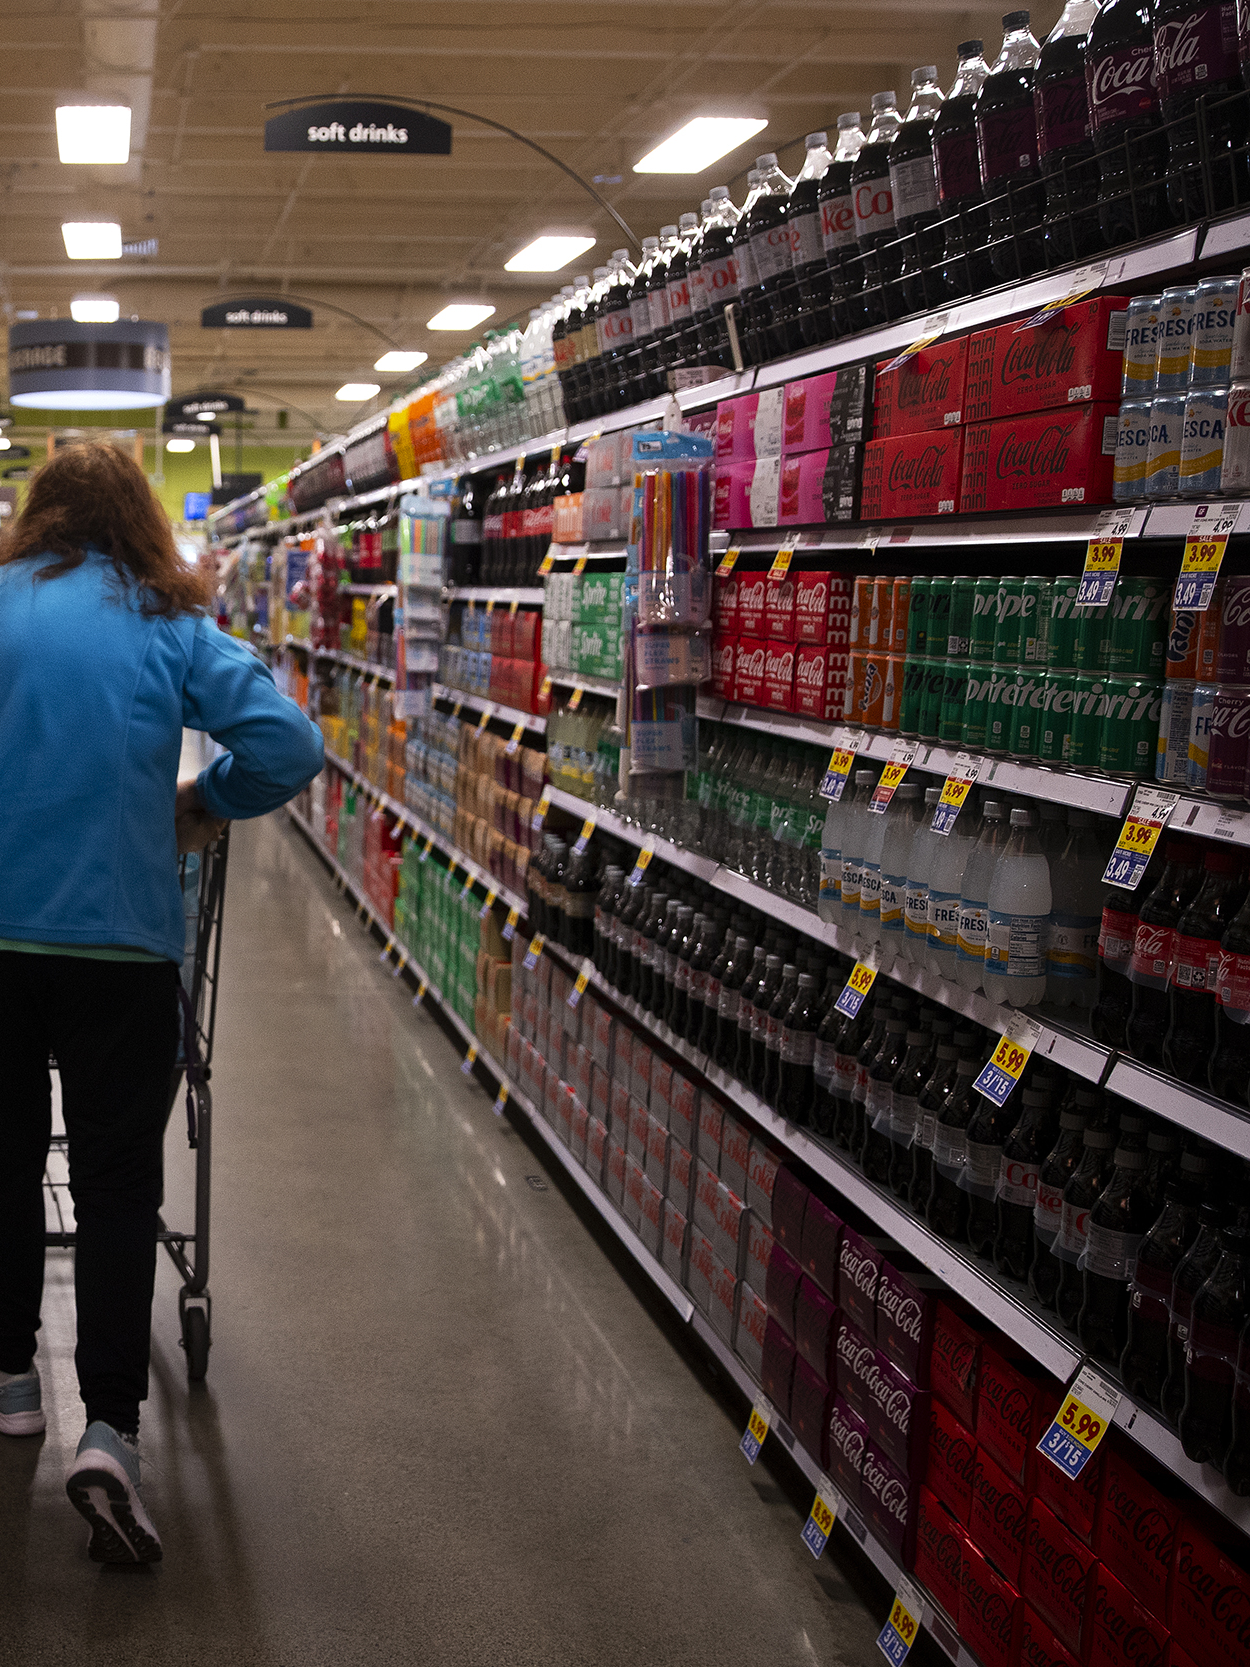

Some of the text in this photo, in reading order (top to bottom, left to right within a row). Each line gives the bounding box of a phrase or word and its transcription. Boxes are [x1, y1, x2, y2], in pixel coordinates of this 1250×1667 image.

[307, 121, 408, 144] soft drinks
[225, 309, 289, 325] soft drinks
[1089, 302, 1098, 314] 10
[971, 330, 997, 356] mini
[1001, 322, 1082, 386] Coca-Cola
[968, 353, 994, 378] mini
[898, 355, 955, 410] Coca-Cola
[967, 375, 992, 398] mini
[1017, 380, 1057, 395] ZERO SUGAR
[965, 400, 991, 421] mini
[996, 423, 1078, 480] Coca-Cola
[888, 443, 949, 492] Coca-Cola
[1012, 479, 1050, 491] ZERO SUGAR
[1111, 523, 1128, 534] 4.99
[1213, 520, 1233, 532] 4.99
[1092, 546, 1115, 562] 3.99
[1189, 544, 1217, 563] 3.99
[1079, 580, 1099, 601] 3.49
[1175, 582, 1197, 605] 3.49
[1218, 697, 1244, 706] Cherry
[834, 755, 849, 768] 3.99
[903, 752, 914, 762] 4.99
[883, 767, 900, 781] 3.99
[965, 769, 978, 778] 4.99
[945, 783, 964, 798] 3.99
[1126, 825, 1152, 844] 3.99
[1106, 857, 1130, 880] 3.49
[851, 968, 872, 990] 5.99
[996, 1043, 1024, 1073] 5.99
[839, 1239, 878, 1301] Coca-Cola
[878, 1275, 921, 1343] Coca-Cola
[836, 1325, 875, 1388] Coca-Cola
[869, 1366, 911, 1436] Coca-Cola
[981, 1361, 1031, 1438] Coca-Cola
[1062, 1402, 1100, 1442] 5.99
[830, 1407, 865, 1472] Coca-Cola
[1048, 1432, 1082, 1466] 3/$15
[1039, 1461, 1060, 1484] ZERO
[862, 1452, 908, 1526] Coca-Cola
[813, 1500, 831, 1531] 8.99
[973, 1463, 1026, 1545] Coca-Cola
[1107, 1470, 1182, 1565] Coca-Cola
[1028, 1518, 1085, 1609] Coca-Cola
[892, 1605, 916, 1639] 8.99
